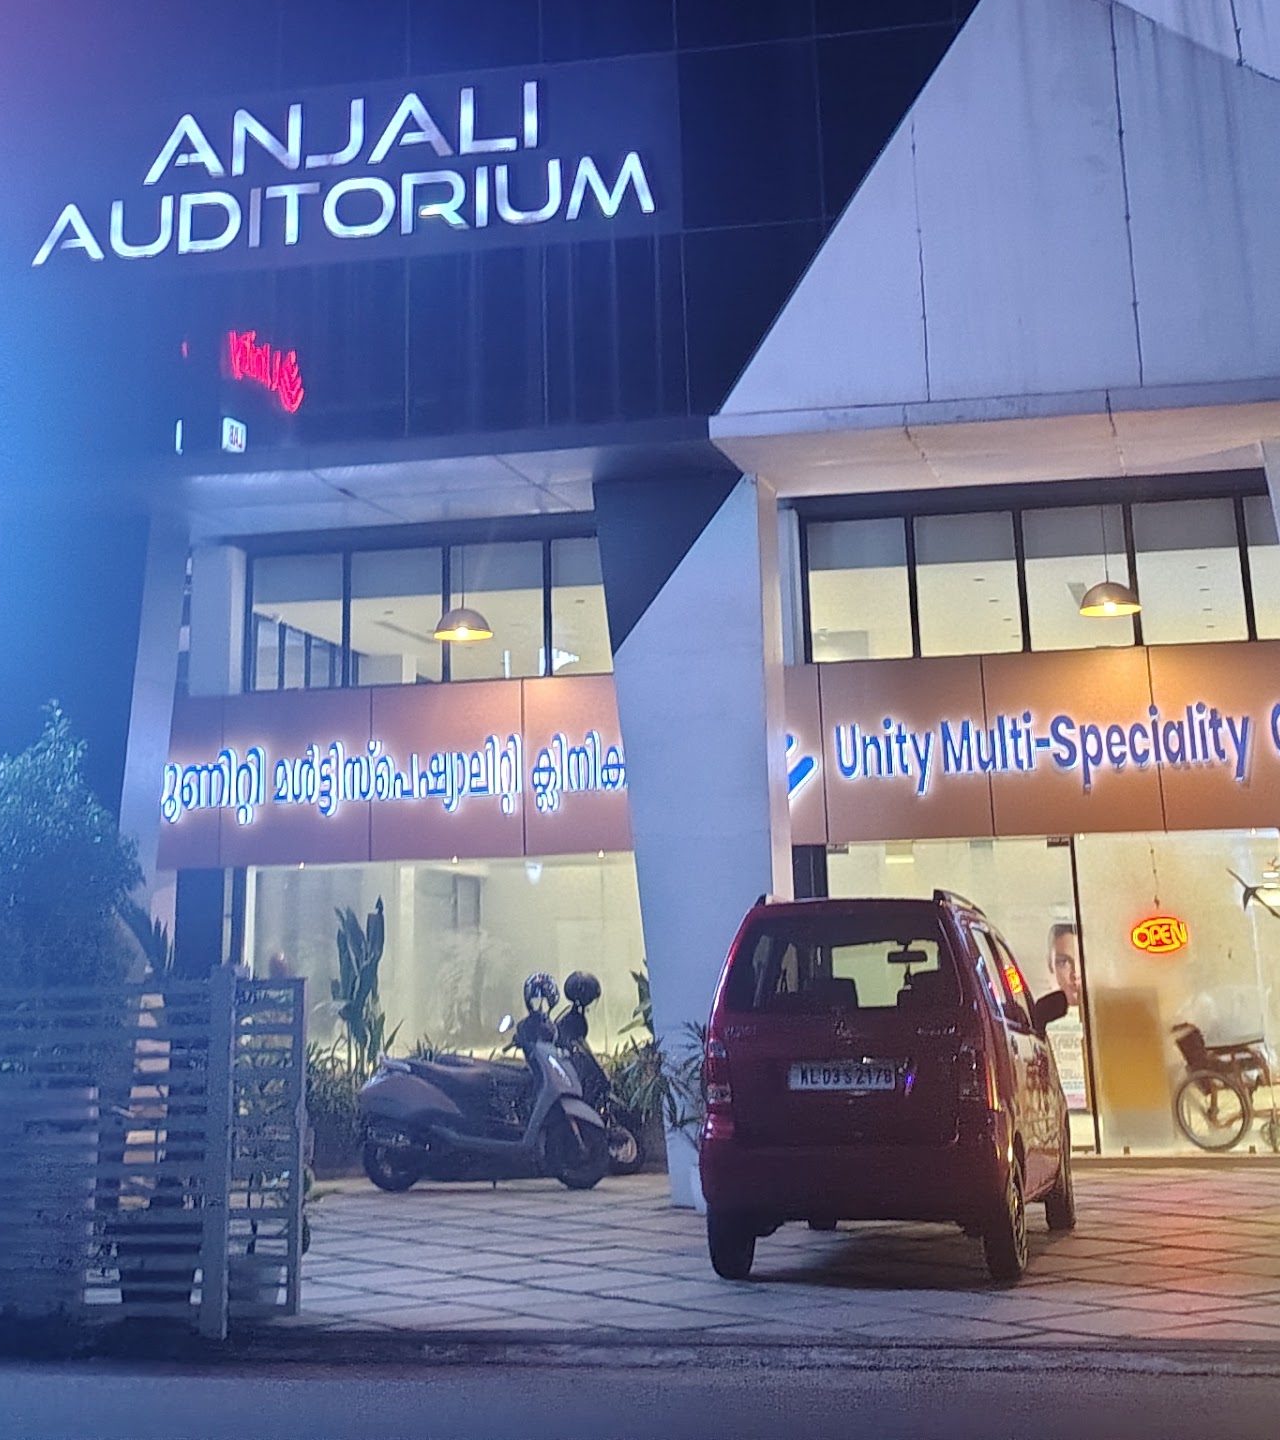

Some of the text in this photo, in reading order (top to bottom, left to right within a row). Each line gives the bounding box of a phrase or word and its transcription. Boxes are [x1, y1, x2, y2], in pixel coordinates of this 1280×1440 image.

[143, 81, 538, 185] ANJALI
[32, 151, 654, 266] AUDITORIUM
[834, 717, 933, 795] Unity
[941, 701, 1250, 790] Multi-Speciality
[1132, 919, 1188, 951] OPEN
